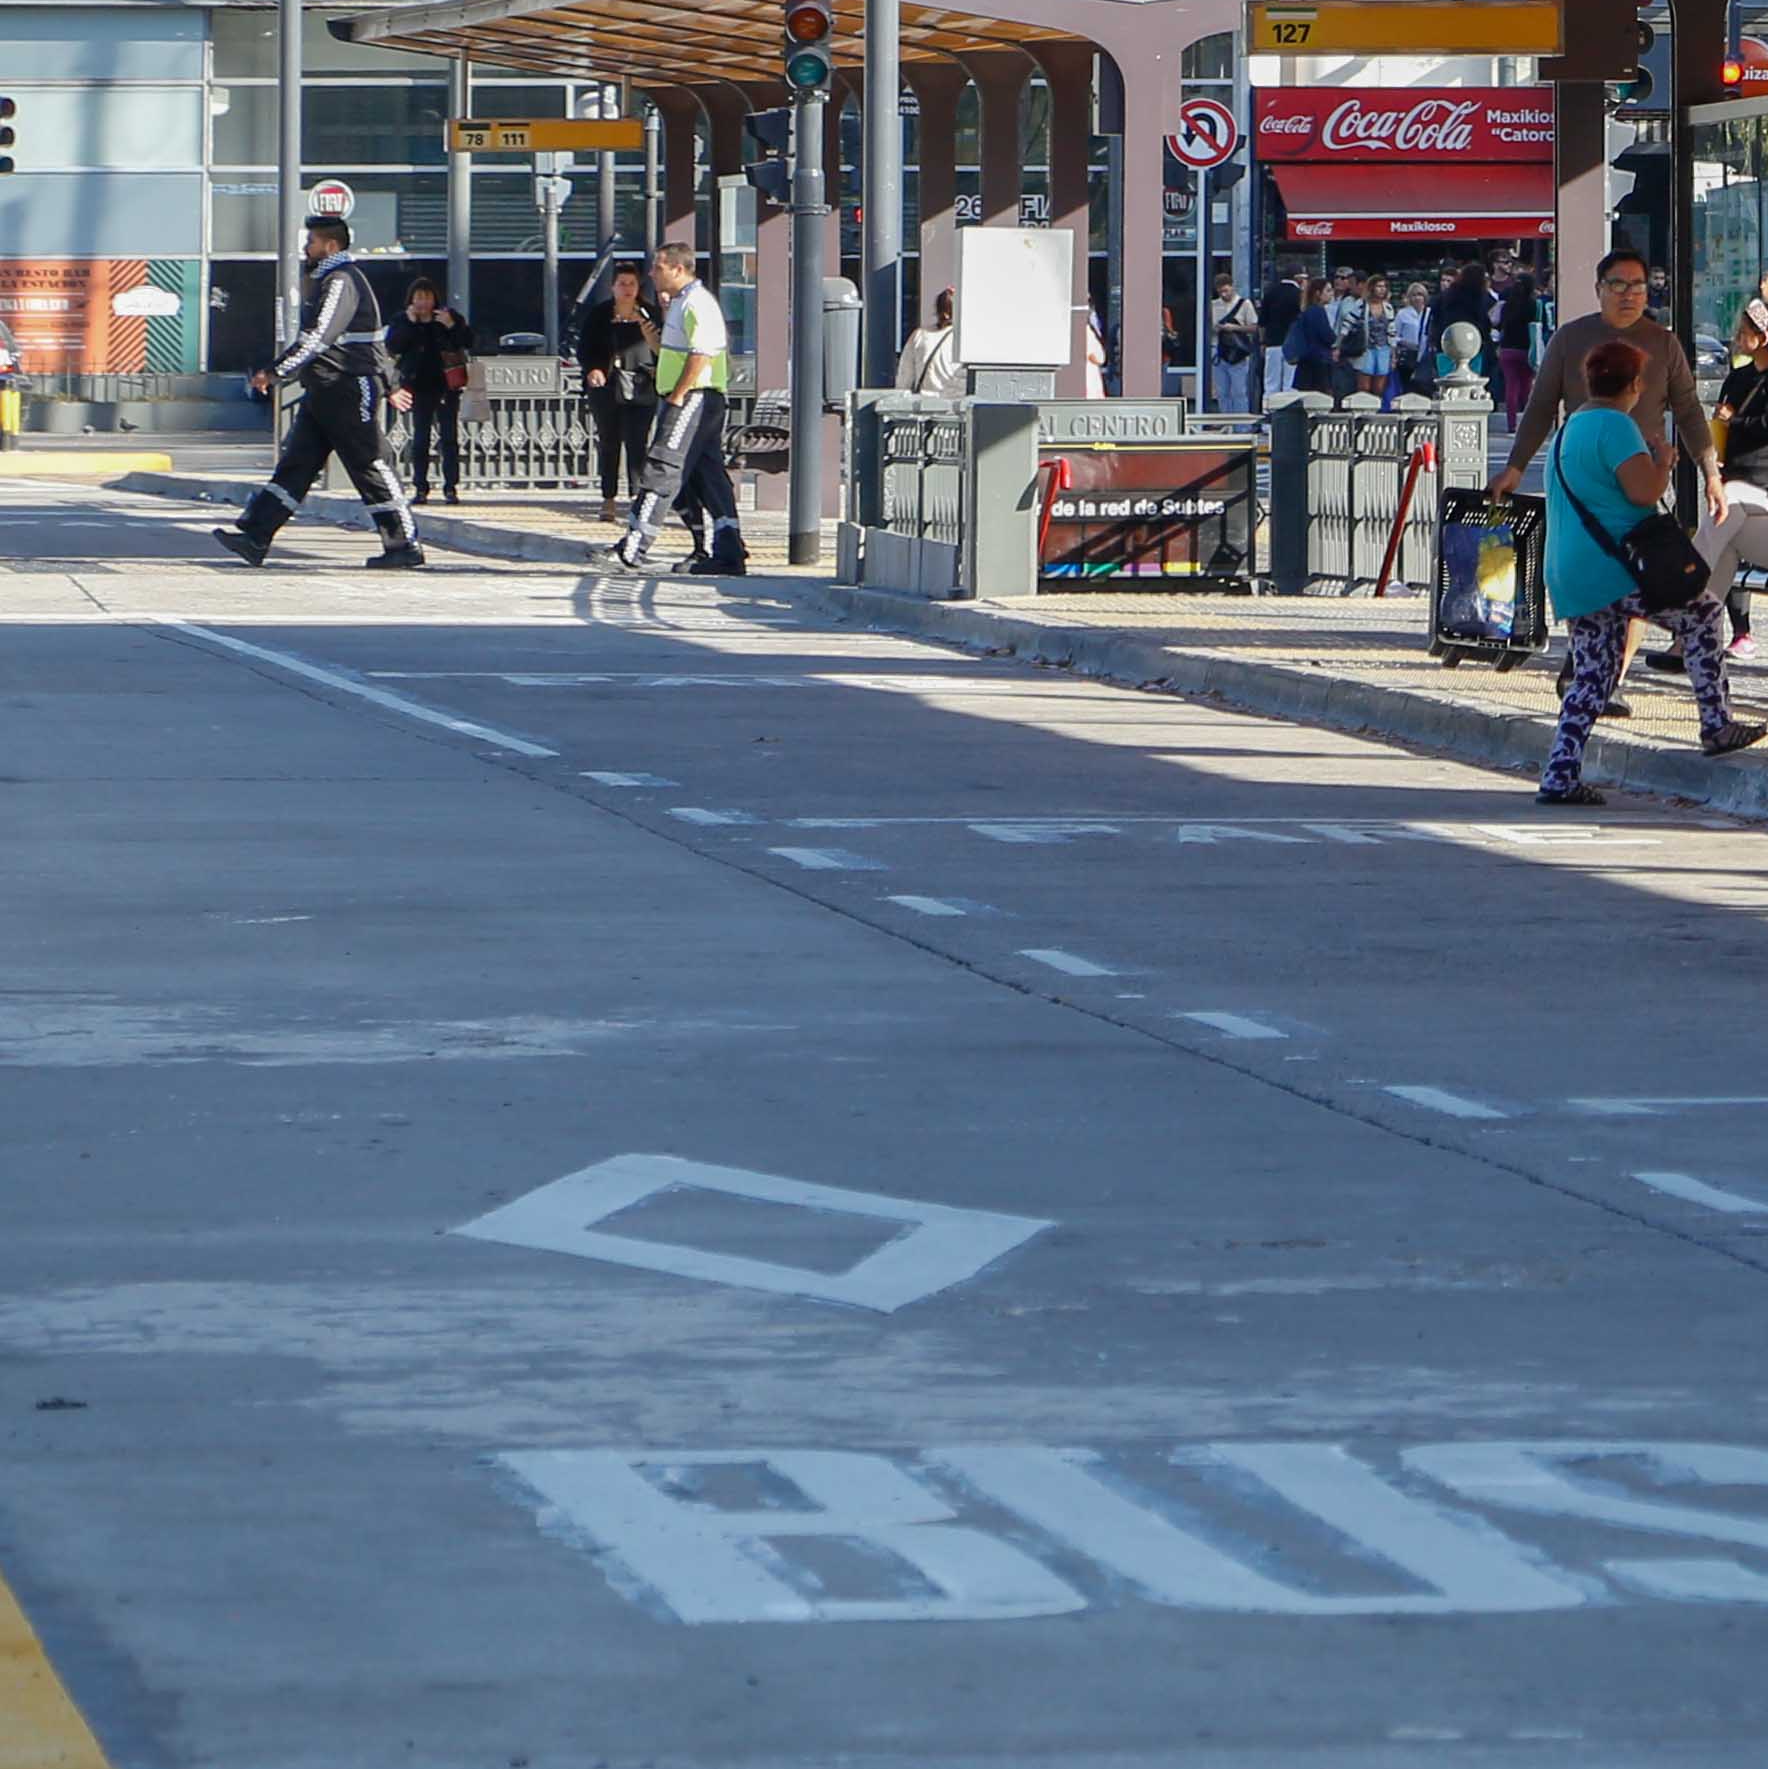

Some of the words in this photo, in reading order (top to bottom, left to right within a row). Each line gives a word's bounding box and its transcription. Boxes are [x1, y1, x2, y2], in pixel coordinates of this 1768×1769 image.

[1271, 23, 1311, 43] 127
[1260, 115, 1314, 134] Coca-Cola
[1321, 98, 1482, 151] Coca-Cola
[465, 133, 484, 146] 78
[502, 133, 526, 145] 111
[319, 193, 345, 212] FIAT
[1390, 221, 1456, 233] Maxikiosco
[1070, 415, 1169, 437] CENTRO
[1051, 499, 1074, 517] de
[1079, 499, 1096, 517] la
[1100, 499, 1130, 517] red
[1134, 499, 1157, 517] de
[1162, 499, 1226, 517] Subtes
